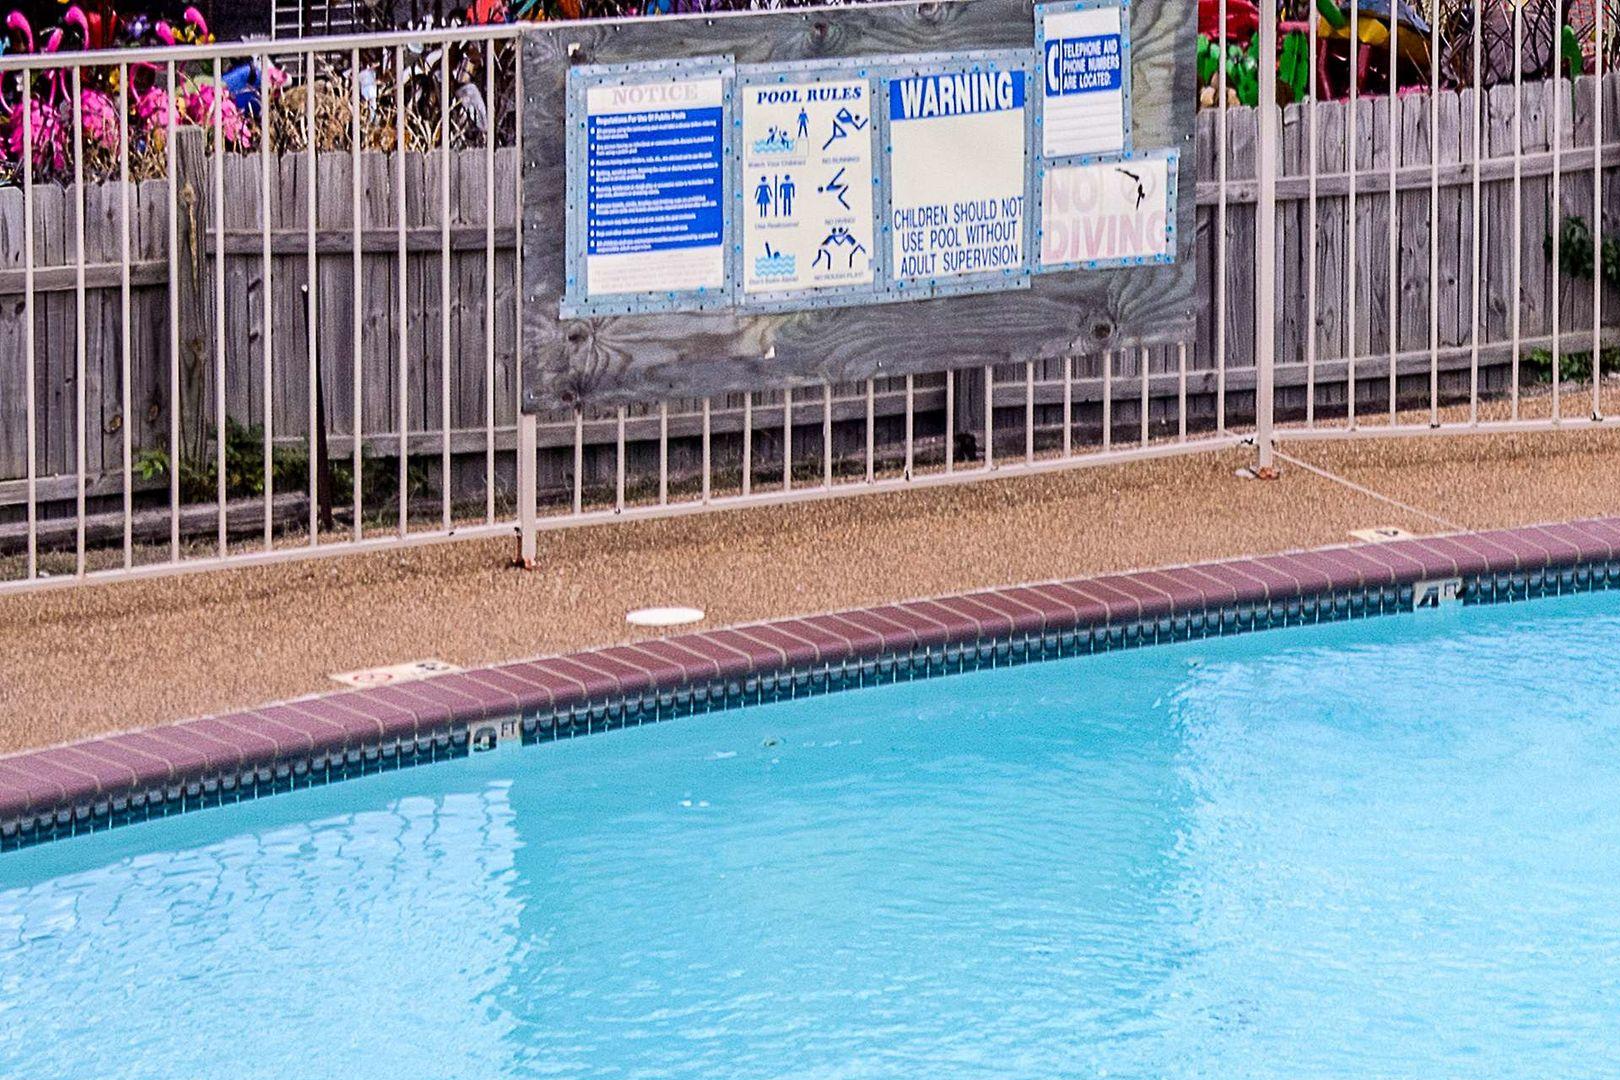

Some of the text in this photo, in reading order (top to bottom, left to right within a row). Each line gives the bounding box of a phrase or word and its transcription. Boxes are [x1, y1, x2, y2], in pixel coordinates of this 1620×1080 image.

[1063, 38, 1118, 58] TELEPHONE AND
[1063, 54, 1120, 74] PHONE NUMBERS
[612, 84, 698, 106] NOTICE
[757, 86, 862, 105] POOL RULES
[900, 71, 1014, 119] WARNING
[1063, 74, 1077, 90] ARE
[1044, 172, 1098, 214] NO
[893, 197, 1024, 231] CHILDREN SHOULD NOT
[901, 220, 1018, 253] USE POOL WITHOUT
[900, 244, 1018, 278] ADULT SUPERVISION
